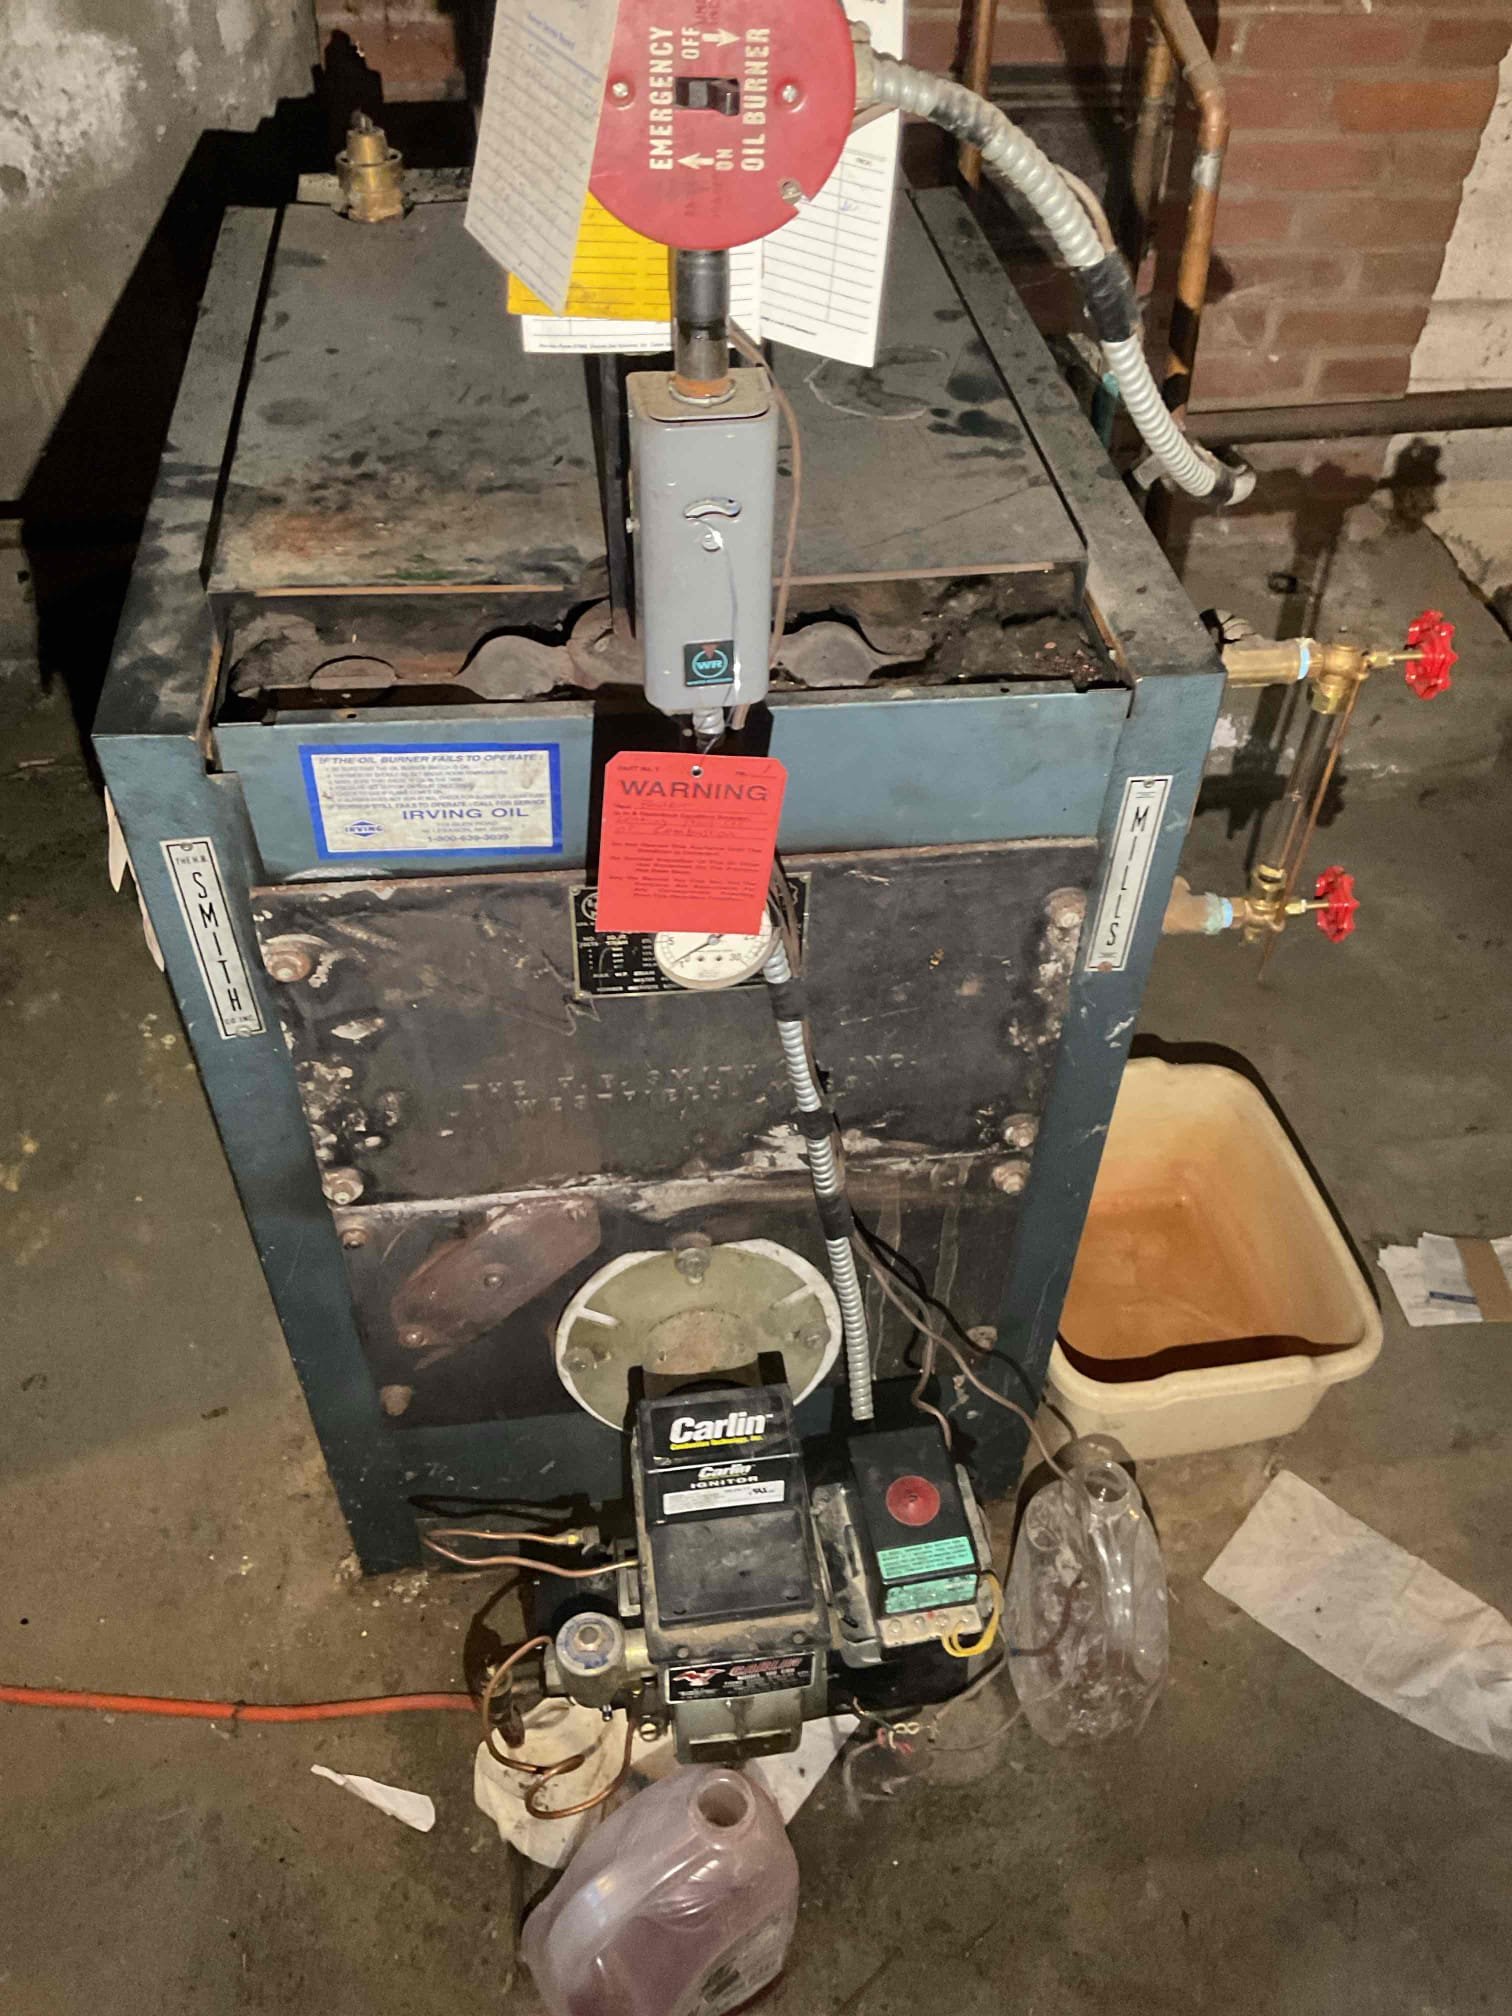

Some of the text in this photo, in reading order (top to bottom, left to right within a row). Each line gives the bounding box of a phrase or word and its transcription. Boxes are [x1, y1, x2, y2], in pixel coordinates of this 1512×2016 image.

[681, 26, 700, 60] OFF
[649, 26, 674, 170] EMERGENCY
[741, 28, 771, 171] OIL BURNER
[715, 148, 734, 171] ON
[696, 660, 722, 670] WR
[358, 756, 376, 764] OIL
[380, 756, 429, 764] BURNER
[466, 754, 481, 762] TO
[483, 753, 535, 761] OPERATE
[620, 779, 769, 801] WARNING
[402, 807, 529, 820] IRVING OIL
[1106, 806, 1149, 946] MILLS
[191, 872, 242, 1012] SMITH
[669, 1411, 766, 1444] Carlin
[690, 1476, 759, 1490] IGNITOR
[697, 1463, 754, 1480] Carlin
